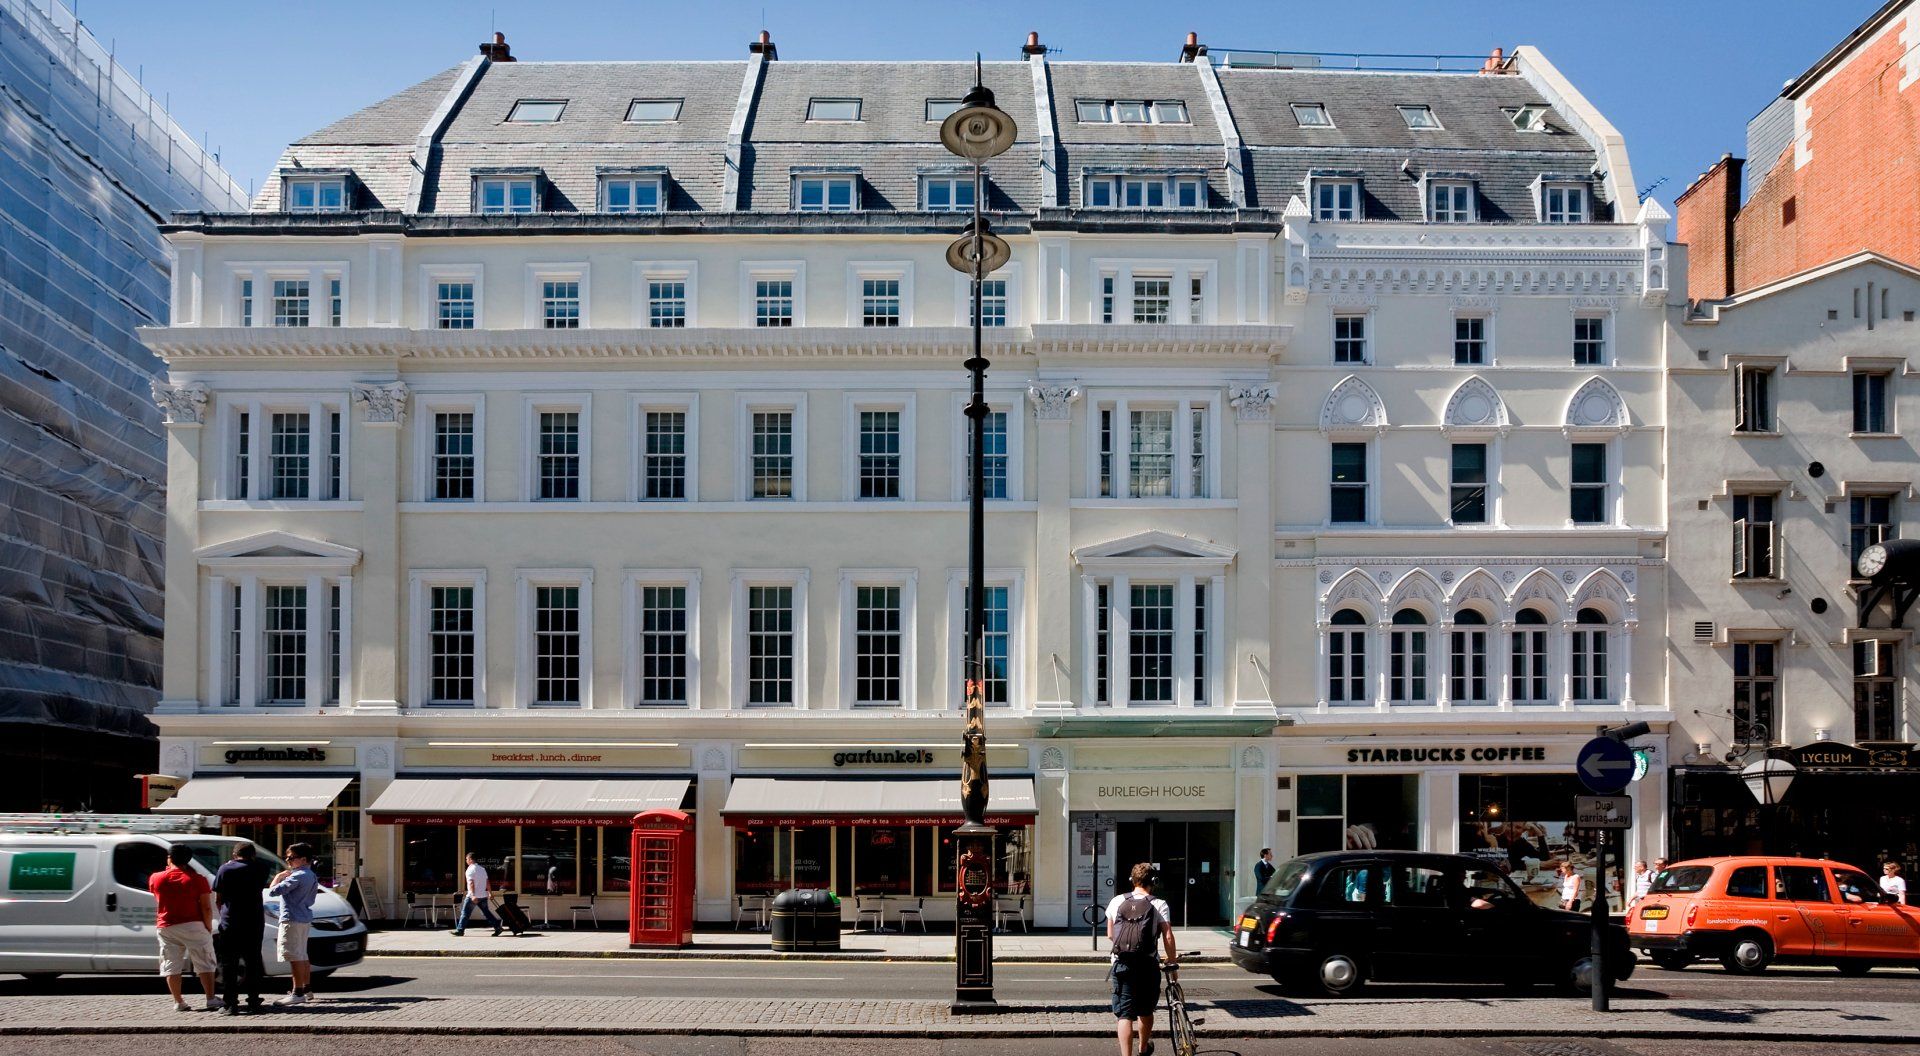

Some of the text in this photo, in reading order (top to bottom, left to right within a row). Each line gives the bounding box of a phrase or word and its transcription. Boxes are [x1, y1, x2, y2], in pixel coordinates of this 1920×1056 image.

[224, 747, 326, 764] garfunkel's
[833, 750, 933, 767] garfunkel's
[1347, 747, 1545, 762] STARBUCKS COFFEE
[1802, 753, 1852, 763] LYCEUM
[1098, 786, 1205, 797] BURLEIGH HOUSE
[1595, 800, 1614, 811] Dual
[458, 817, 482, 825] pastries
[812, 818, 836, 826] pastries
[905, 817, 939, 825] sandwiches
[948, 818, 966, 826] wrap
[18, 866, 66, 876] HARTE
